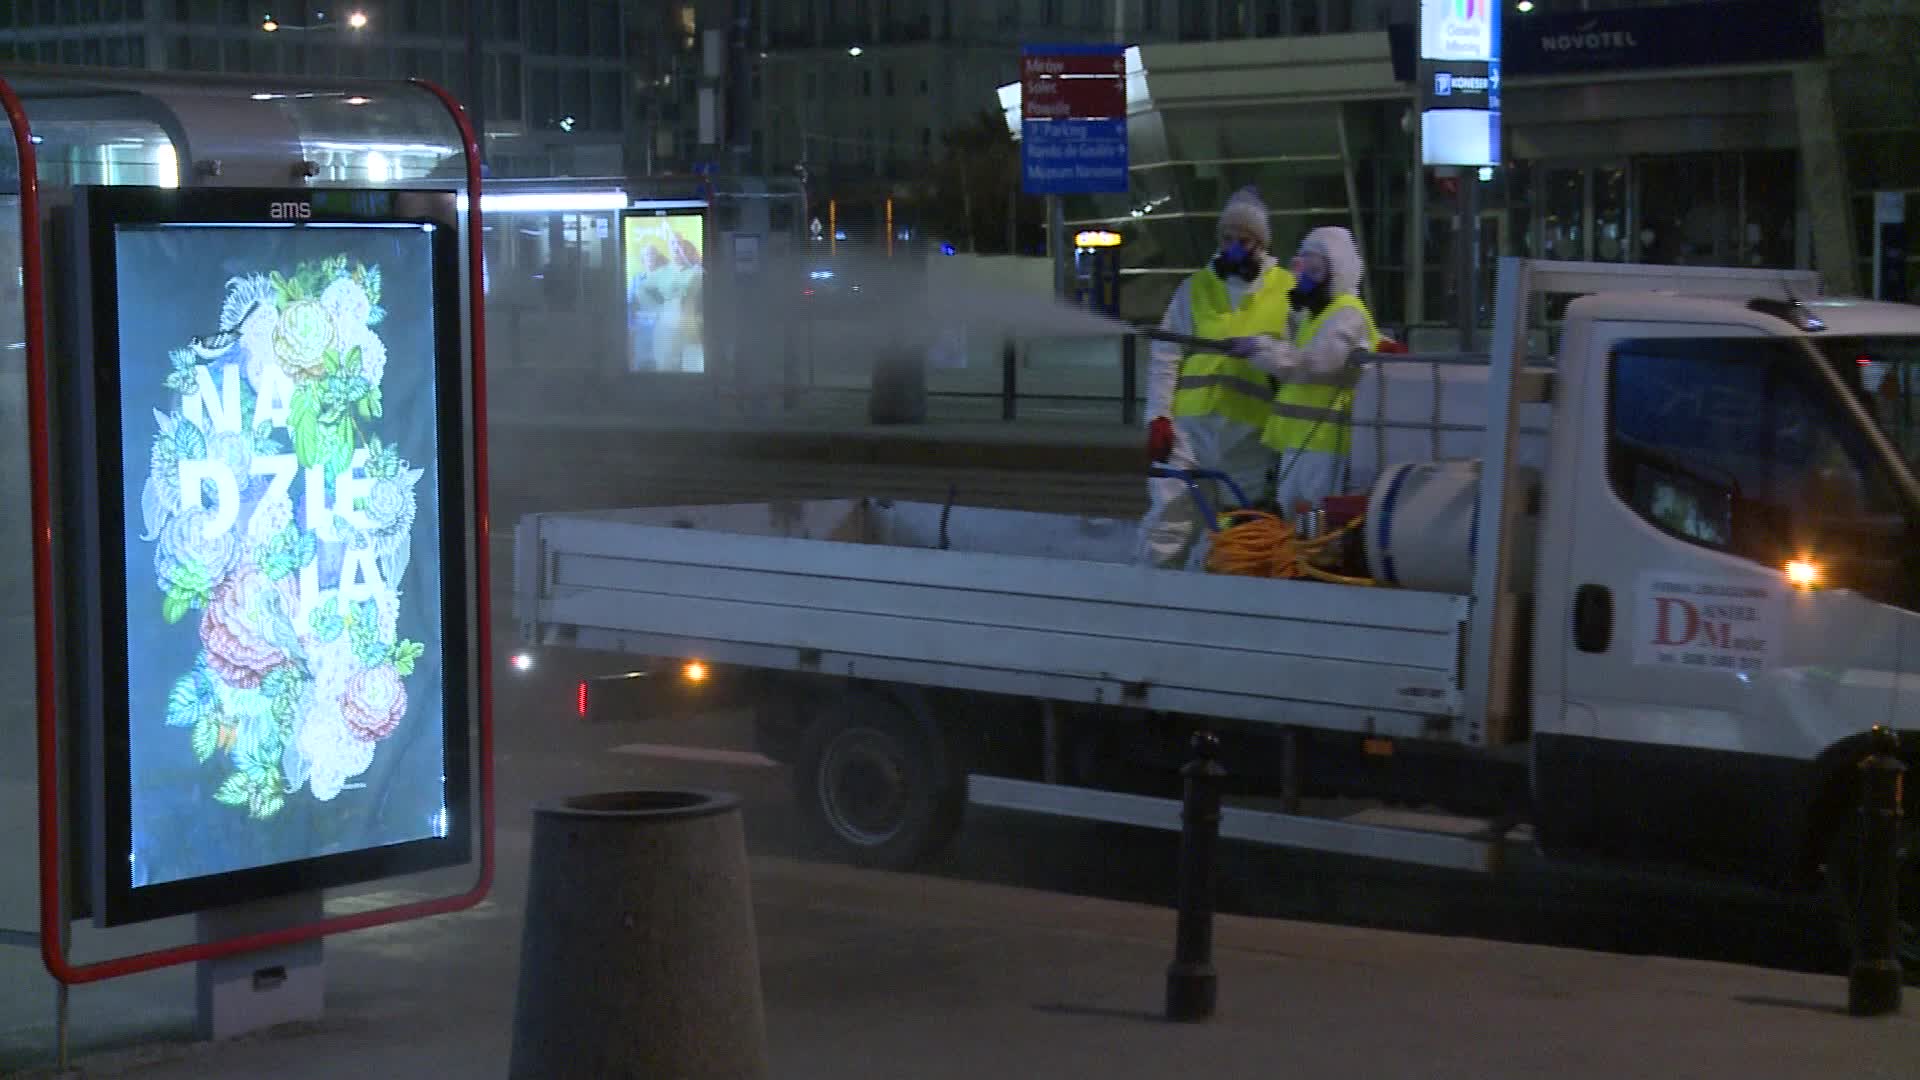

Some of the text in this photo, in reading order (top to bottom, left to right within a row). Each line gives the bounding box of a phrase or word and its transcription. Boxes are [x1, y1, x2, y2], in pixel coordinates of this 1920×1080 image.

[1541, 32, 1638, 51] NOVOTEL
[270, 202, 312, 219] ams
[182, 364, 296, 435] NA
[179, 448, 383, 541] DZIE
